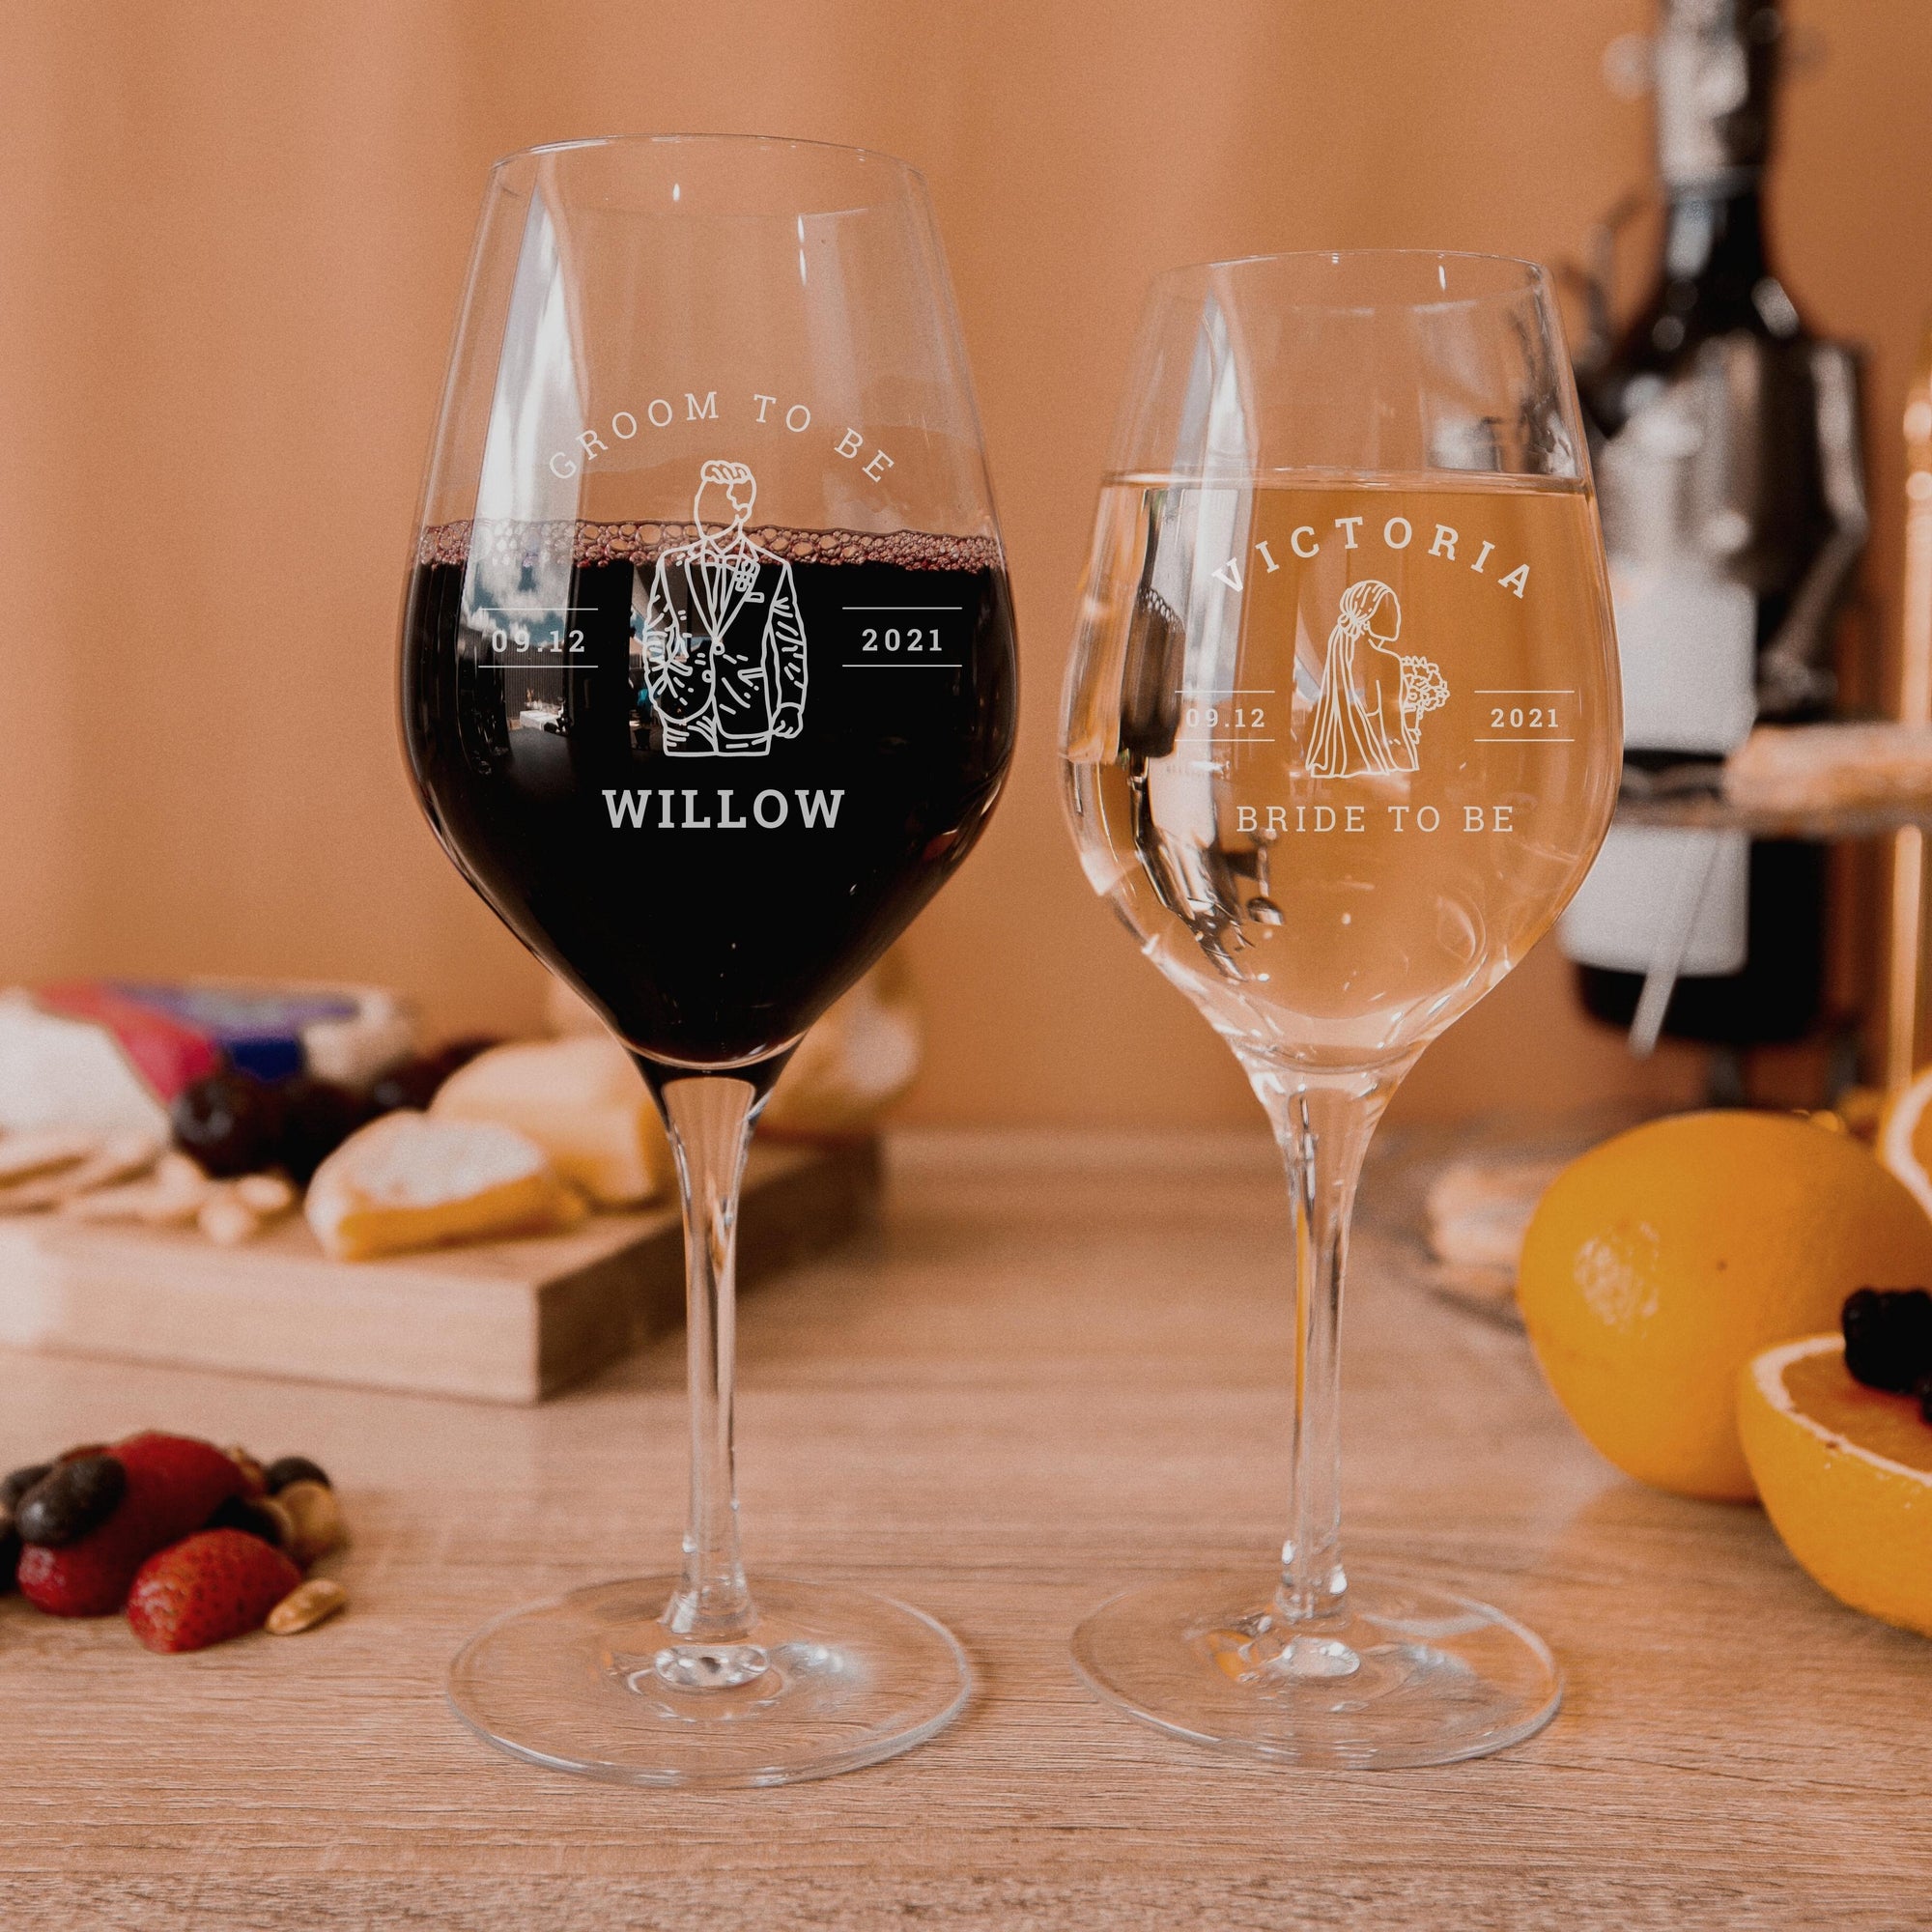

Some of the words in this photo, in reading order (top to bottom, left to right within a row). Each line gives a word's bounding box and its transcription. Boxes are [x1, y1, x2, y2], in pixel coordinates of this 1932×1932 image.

[549, 391, 719, 479] GROOM
[753, 393, 811, 433] TO
[834, 428, 895, 482] BE
[1211, 516, 1531, 599] VICTORIA
[491, 630, 585, 653] 09.12
[861, 628, 944, 652] 2021
[1185, 707, 1265, 728] 09.12
[1490, 707, 1560, 728] 2021
[601, 788, 845, 829] WILLOW
[1236, 806, 1366, 833] BRIDE
[1387, 806, 1440, 833] TO
[1463, 806, 1515, 833] BE
